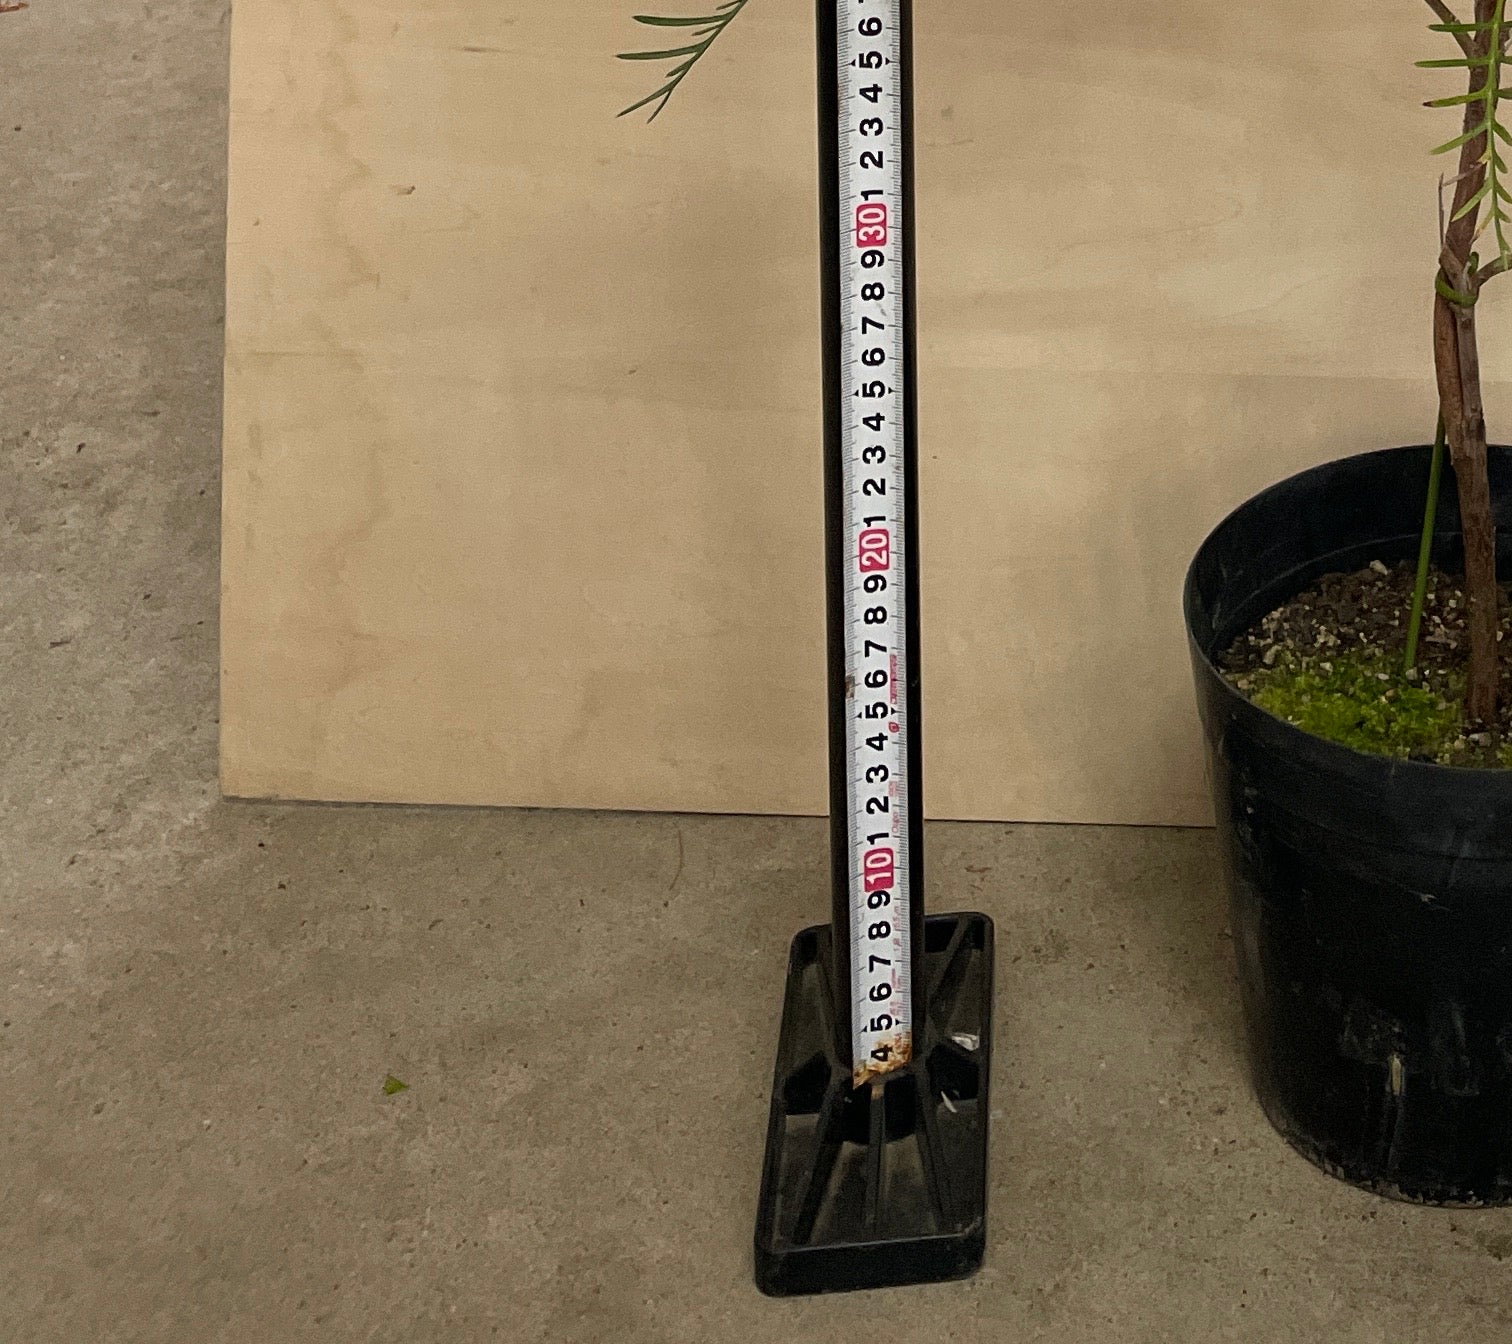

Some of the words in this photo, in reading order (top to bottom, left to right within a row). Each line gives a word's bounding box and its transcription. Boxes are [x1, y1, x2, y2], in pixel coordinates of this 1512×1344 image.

[857, 17, 883, 37] 6
[858, 50, 883, 69] 5
[859, 83, 883, 104] 4
[859, 117, 884, 137] 3
[859, 150, 884, 170] 2
[860, 189, 884, 201] 1
[859, 207, 885, 241] 30
[860, 249, 885, 269] 9
[860, 282, 885, 301] 8
[861, 316, 885, 335] 7
[861, 347, 886, 367] 6
[861, 380, 886, 399] 5
[862, 412, 886, 432] 4
[862, 445, 887, 465] 3
[862, 478, 886, 497] 2
[863, 515, 887, 528] 1
[861, 533, 887, 566] 20
[863, 574, 887, 594] 9
[863, 605, 888, 625] 8
[864, 639, 888, 658] 7
[864, 669, 888, 689] 6
[864, 701, 889, 719] 5
[865, 732, 889, 752] 4
[865, 764, 889, 784] 3
[865, 795, 889, 815] 2
[866, 832, 890, 846] 1
[866, 853, 891, 884] 10
[867, 890, 891, 910] 9
[867, 920, 891, 941] 8
[868, 954, 892, 973] 7
[868, 982, 892, 1002] 6
[870, 1013, 893, 1032] 5
[870, 1044, 893, 1063] 4
